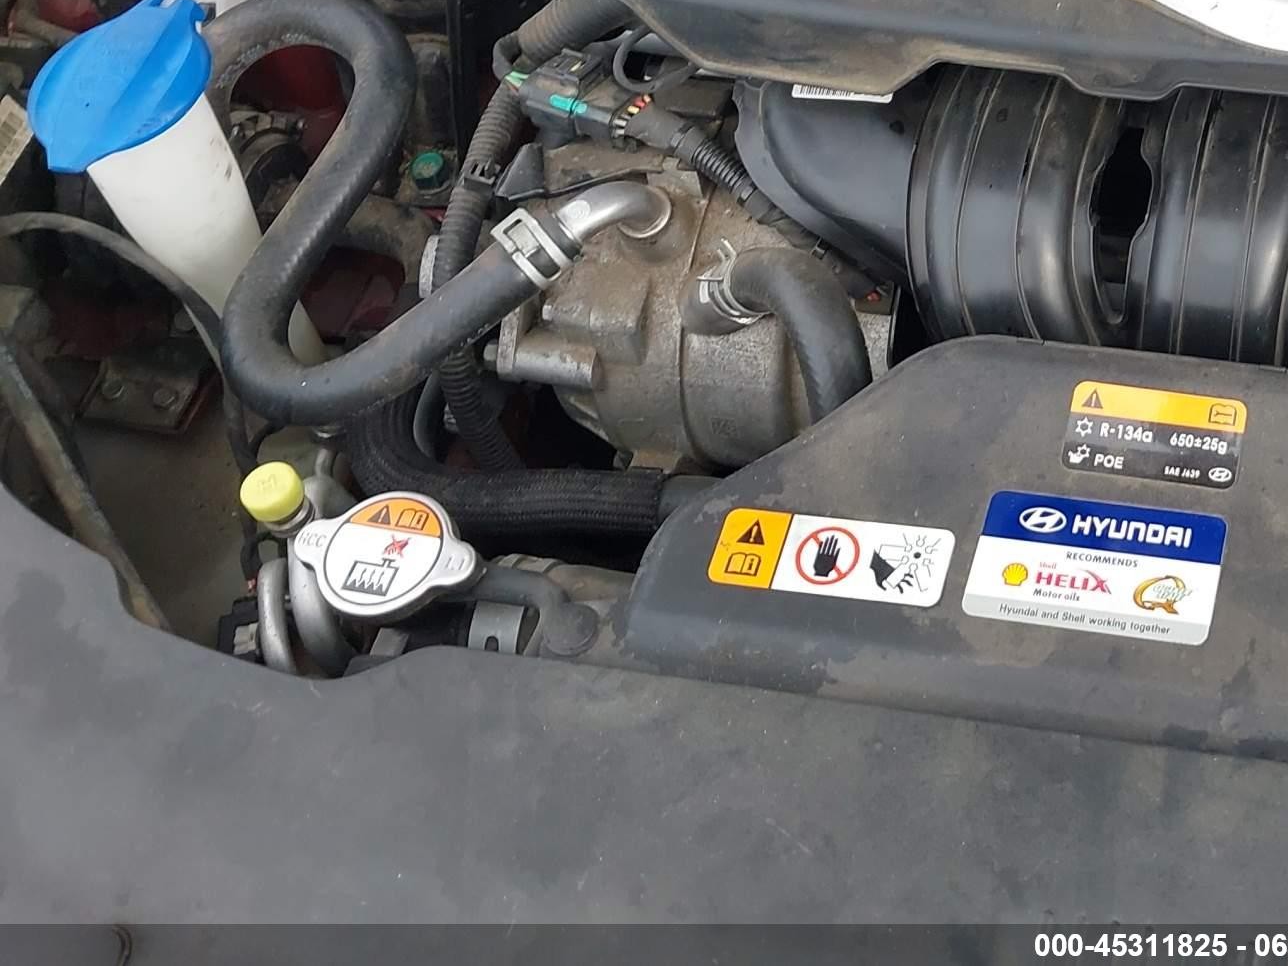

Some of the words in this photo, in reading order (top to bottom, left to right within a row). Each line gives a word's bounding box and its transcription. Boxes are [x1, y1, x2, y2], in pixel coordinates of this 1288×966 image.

[1100, 422, 1153, 444] R-134a
[1169, 431, 1228, 455] 650±25g
[1094, 453, 1124, 469] POE
[1071, 514, 1193, 548] HYUNDAI
[1065, 551, 1139, 568] RECOMMENDS
[1032, 587, 1062, 600] Motor
[1063, 591, 1081, 602] oils
[1035, 568, 1112, 595] HELIX
[999, 603, 1038, 619] Hyundai
[1041, 609, 1060, 620] and
[1062, 611, 1086, 623] Shell
[1088, 615, 1127, 631] working
[1130, 621, 1171, 636] together
